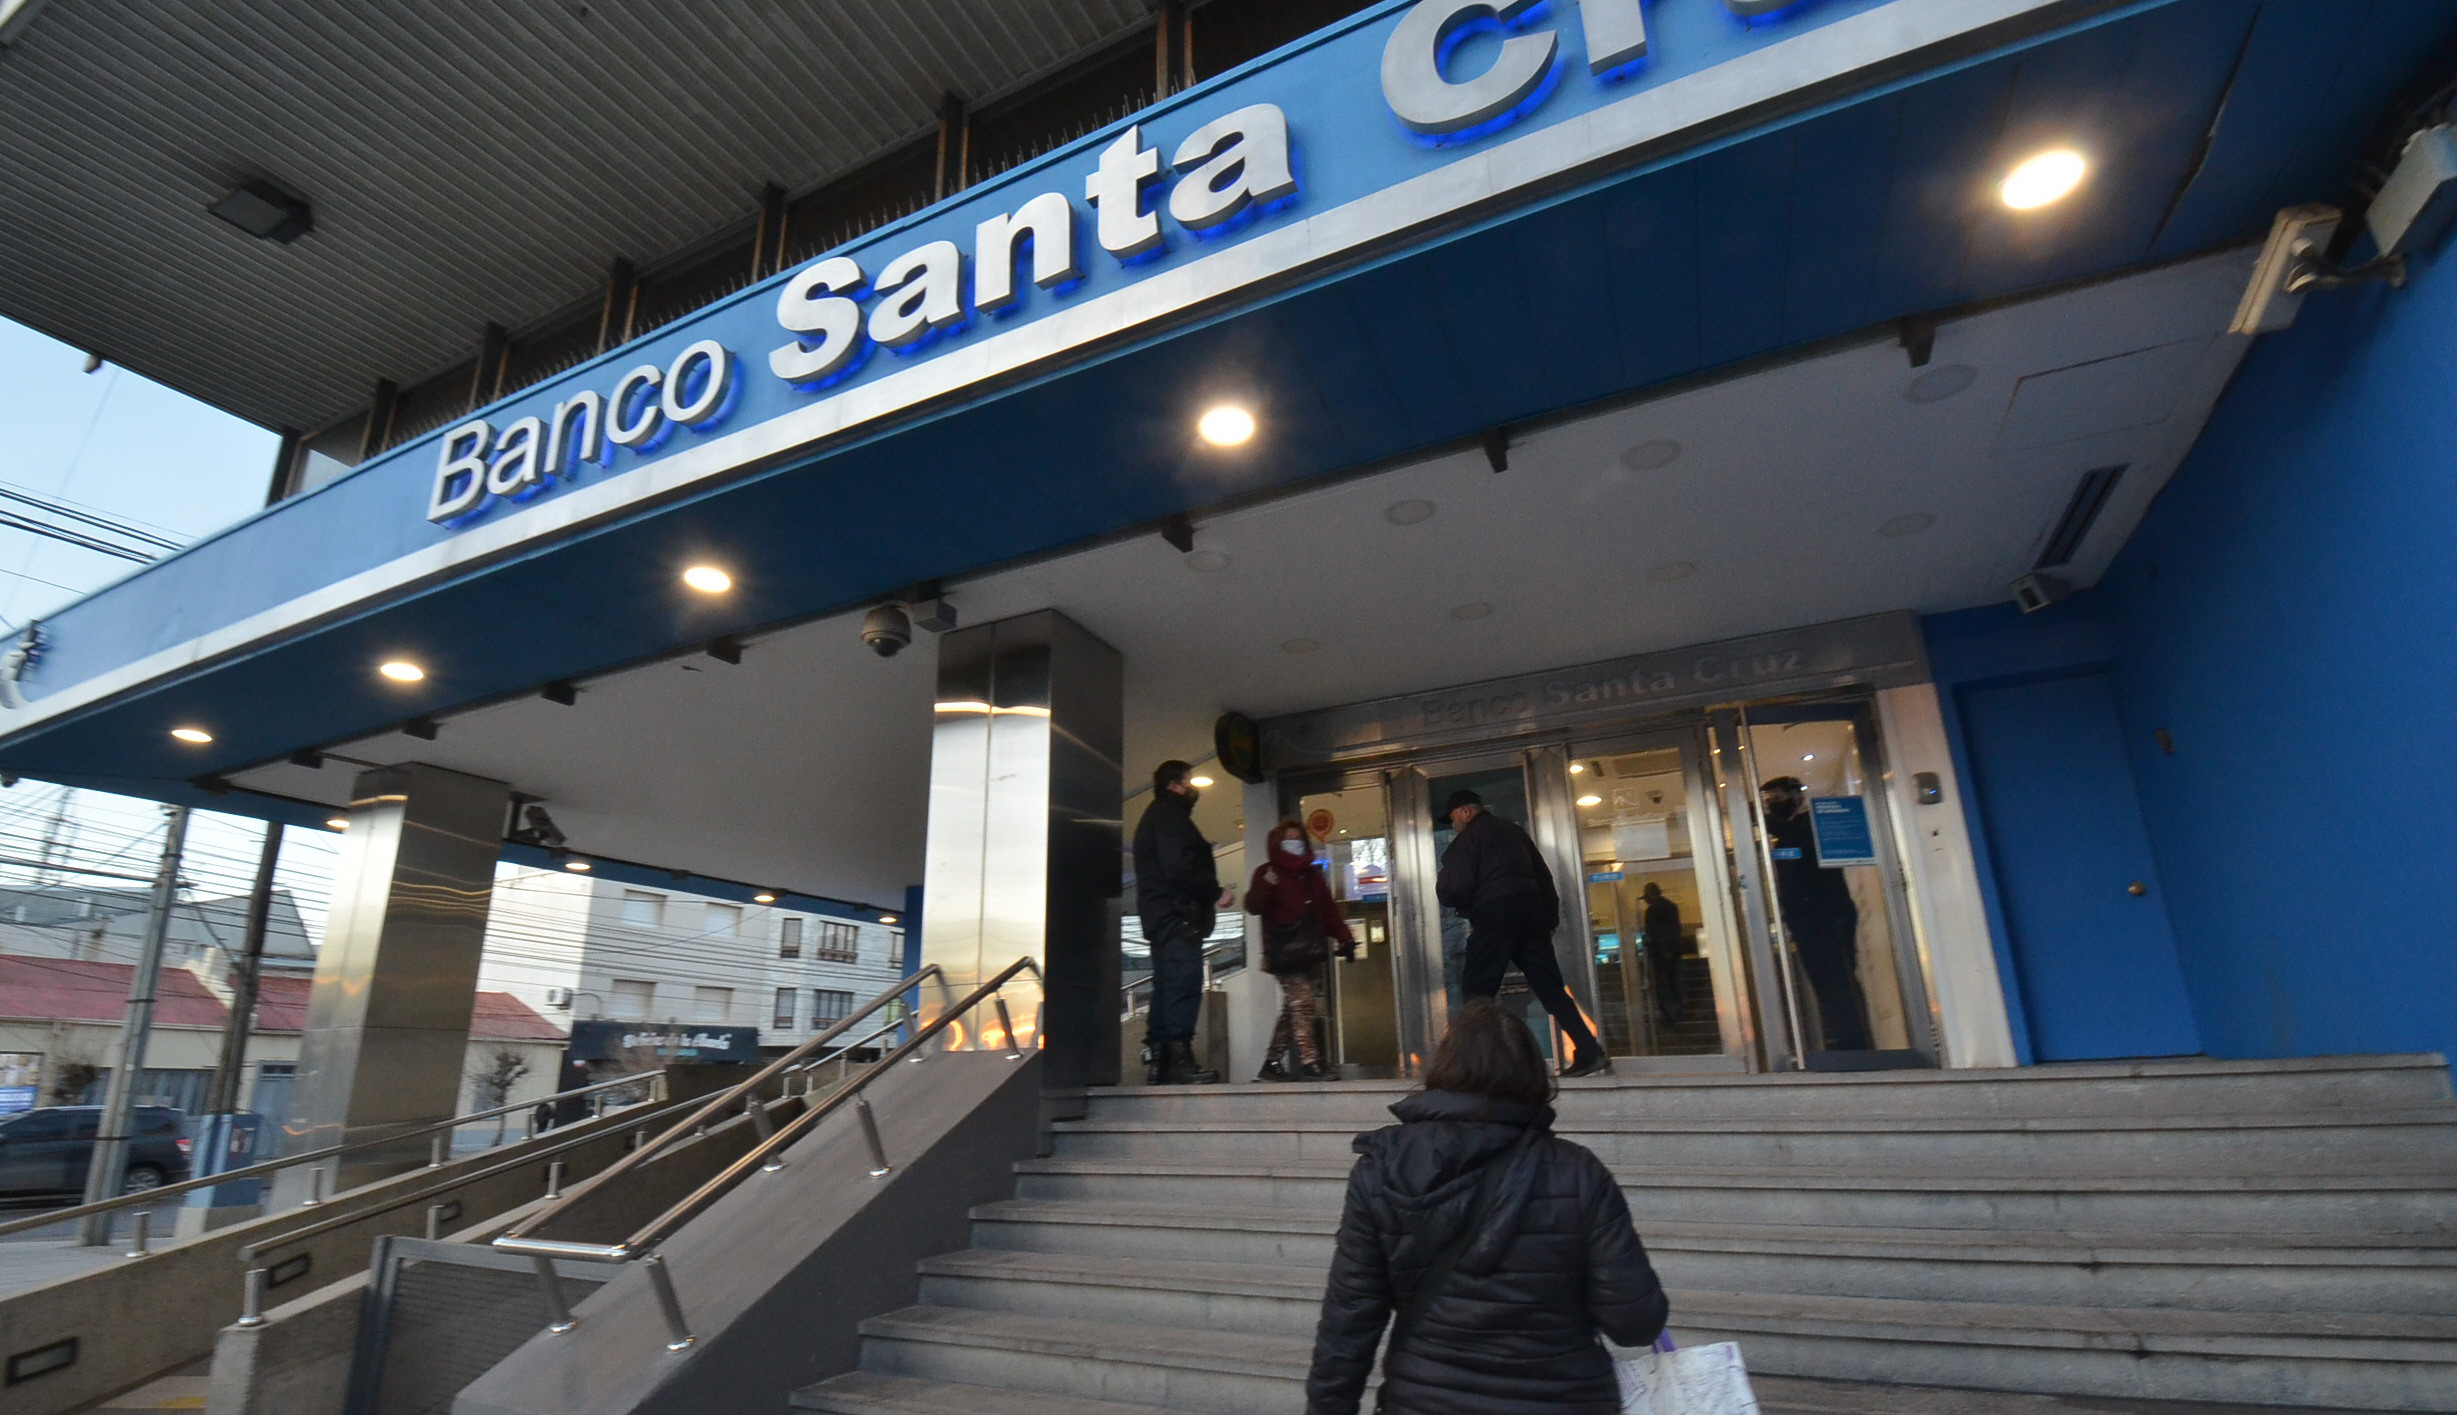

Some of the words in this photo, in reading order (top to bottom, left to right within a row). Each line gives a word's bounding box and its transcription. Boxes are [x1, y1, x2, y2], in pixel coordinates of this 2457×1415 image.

[426, 339, 734, 524] Banco
[769, 102, 1298, 383] Santa
[1421, 691, 1527, 726] Banco
[1545, 668, 1675, 705] Santa
[1692, 650, 1802, 684] Cruz
